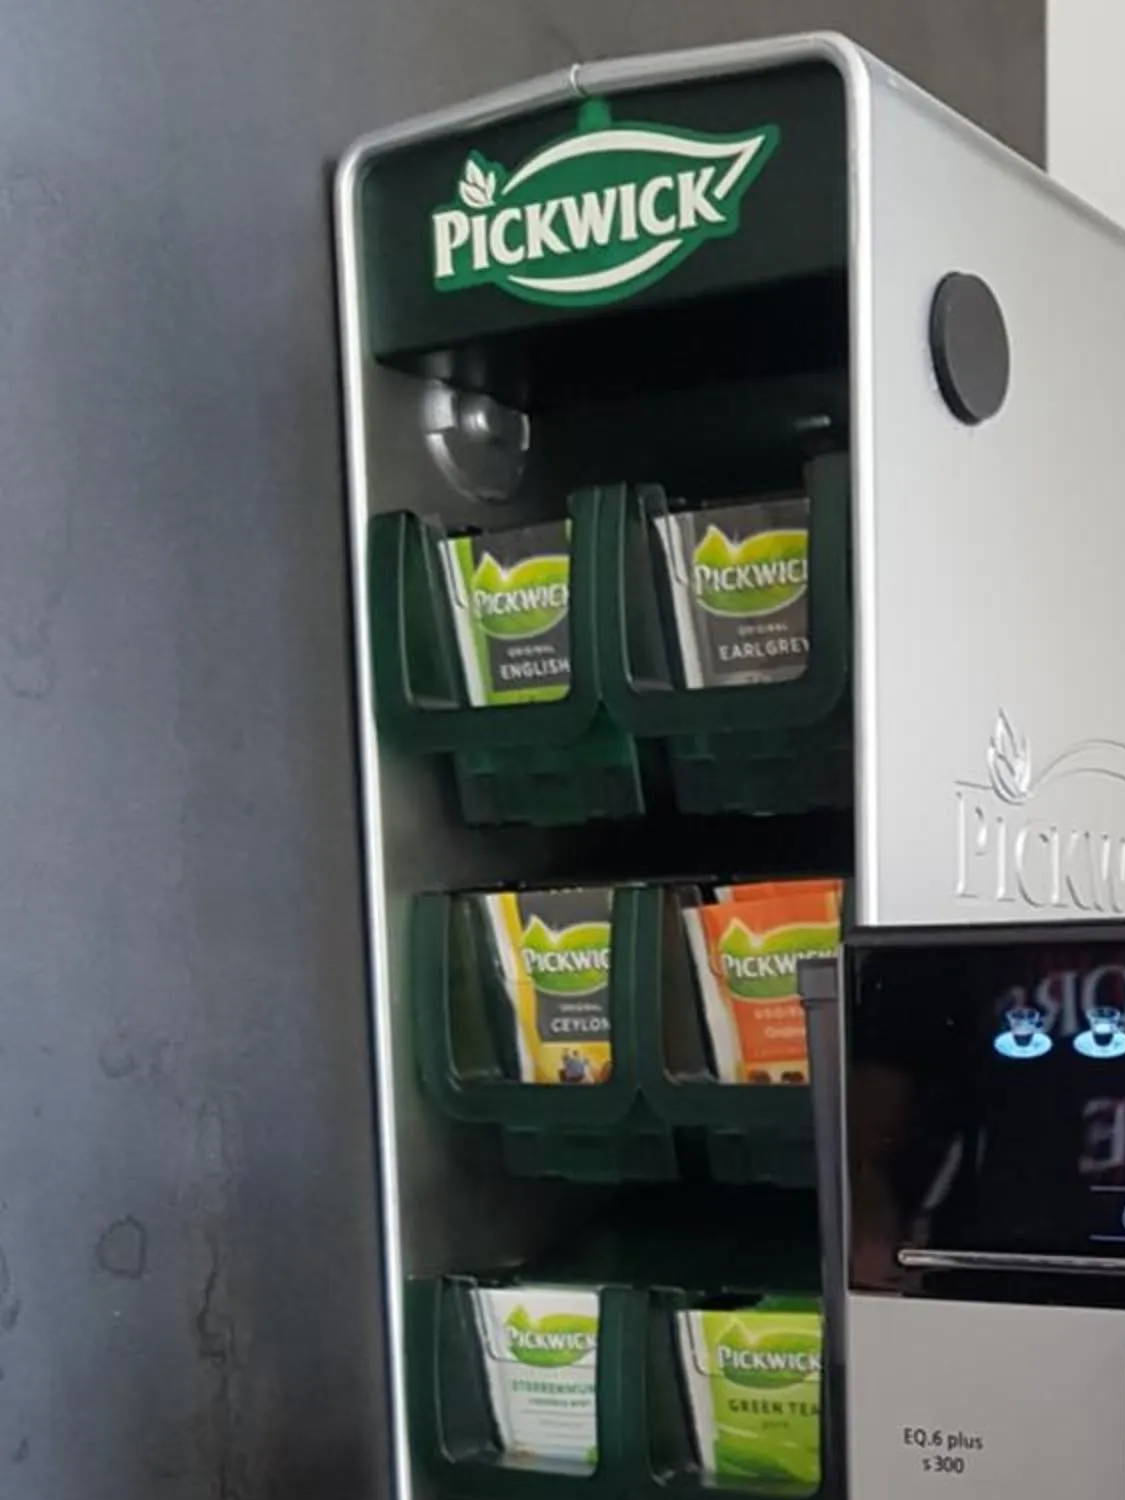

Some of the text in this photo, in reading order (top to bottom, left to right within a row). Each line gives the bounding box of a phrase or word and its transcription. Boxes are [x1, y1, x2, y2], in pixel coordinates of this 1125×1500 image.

[432, 166, 727, 279] PICKWICK
[473, 583, 570, 617] PICKWIC
[523, 947, 612, 976] PICKWIC
[728, 1398, 784, 1415] GREEN
[903, 1426, 983, 1452] EQ.6 plus
[934, 1455, 965, 1474] 300
